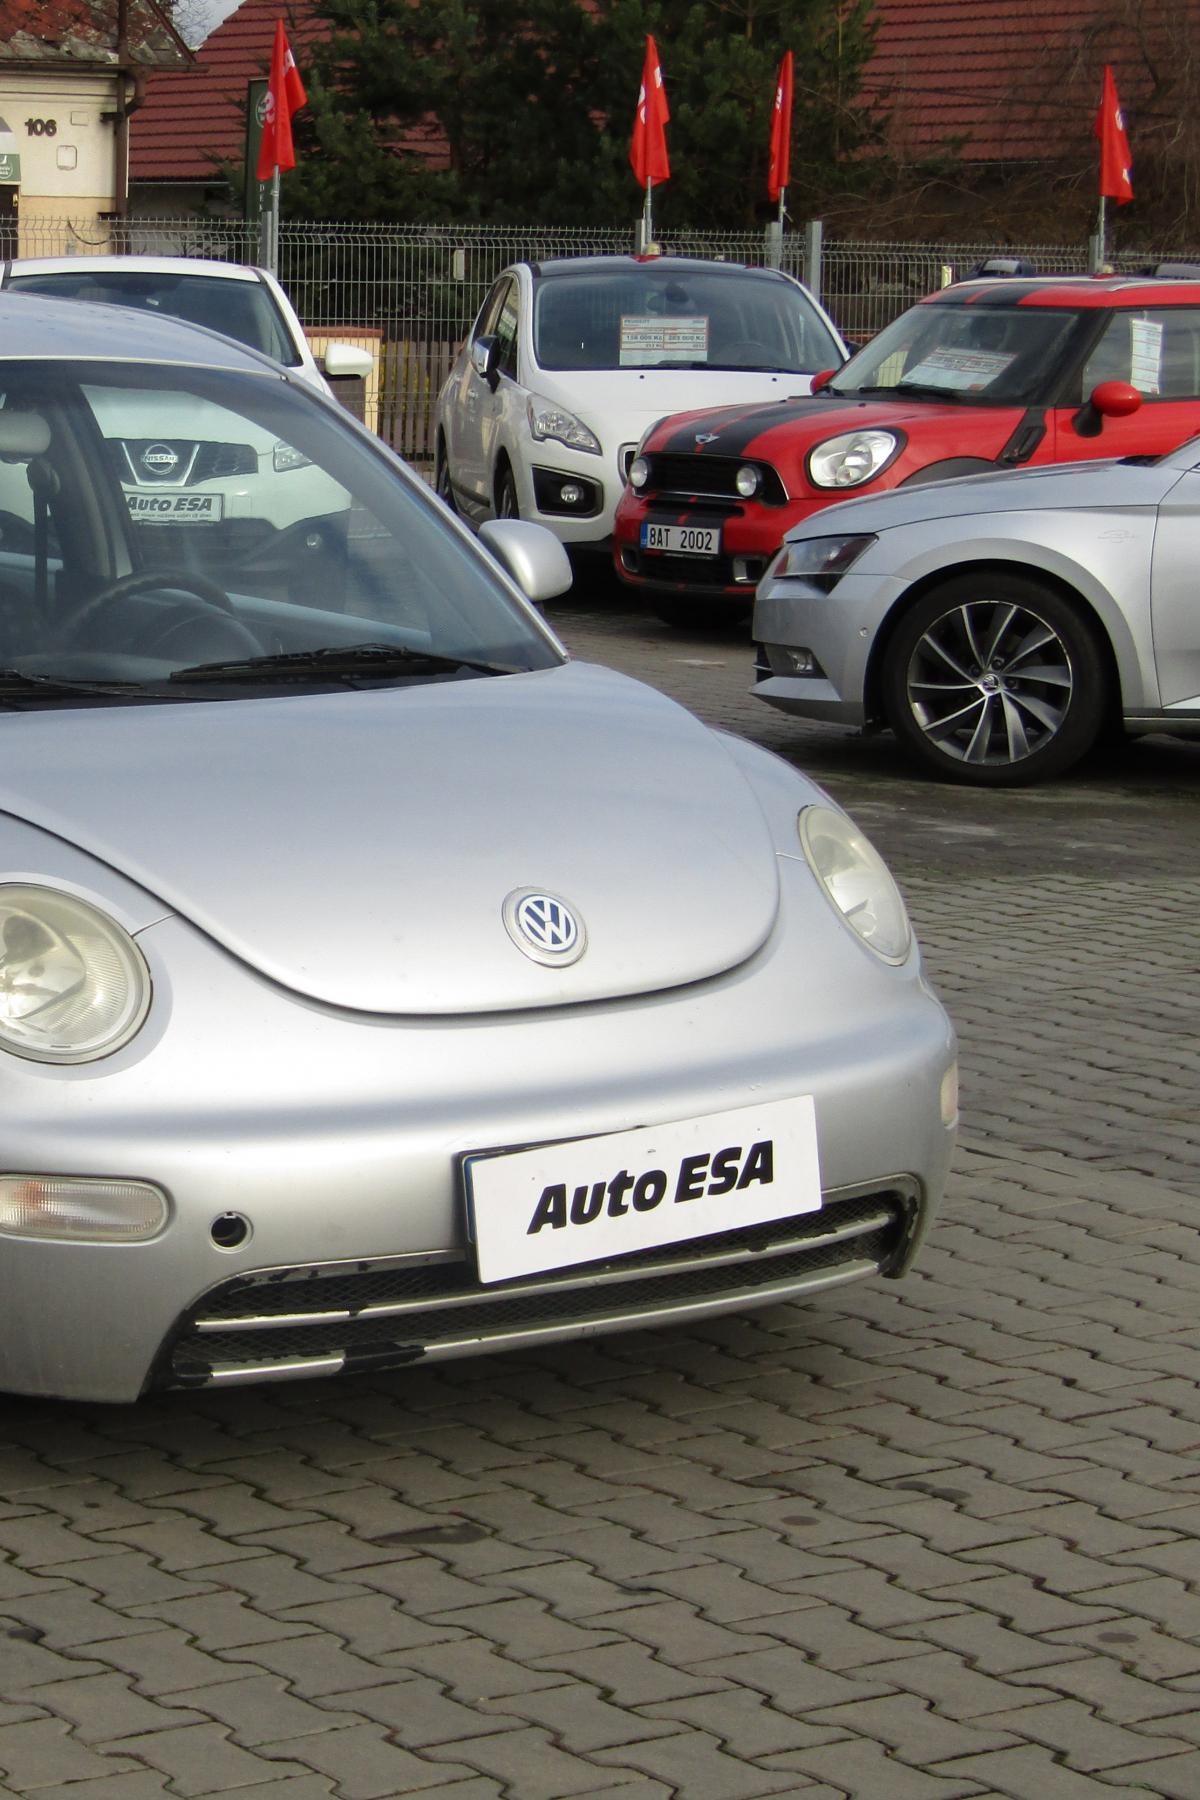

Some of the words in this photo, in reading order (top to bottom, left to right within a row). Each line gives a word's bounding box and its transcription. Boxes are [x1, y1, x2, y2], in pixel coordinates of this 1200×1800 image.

[24, 118, 57, 137] 106
[127, 496, 172, 512] Auto
[173, 497, 213, 512] ESA
[649, 527, 671, 547] 8AT
[680, 530, 712, 551] 2002
[526, 1169, 667, 1235] Auto
[673, 1140, 774, 1204] ESA
